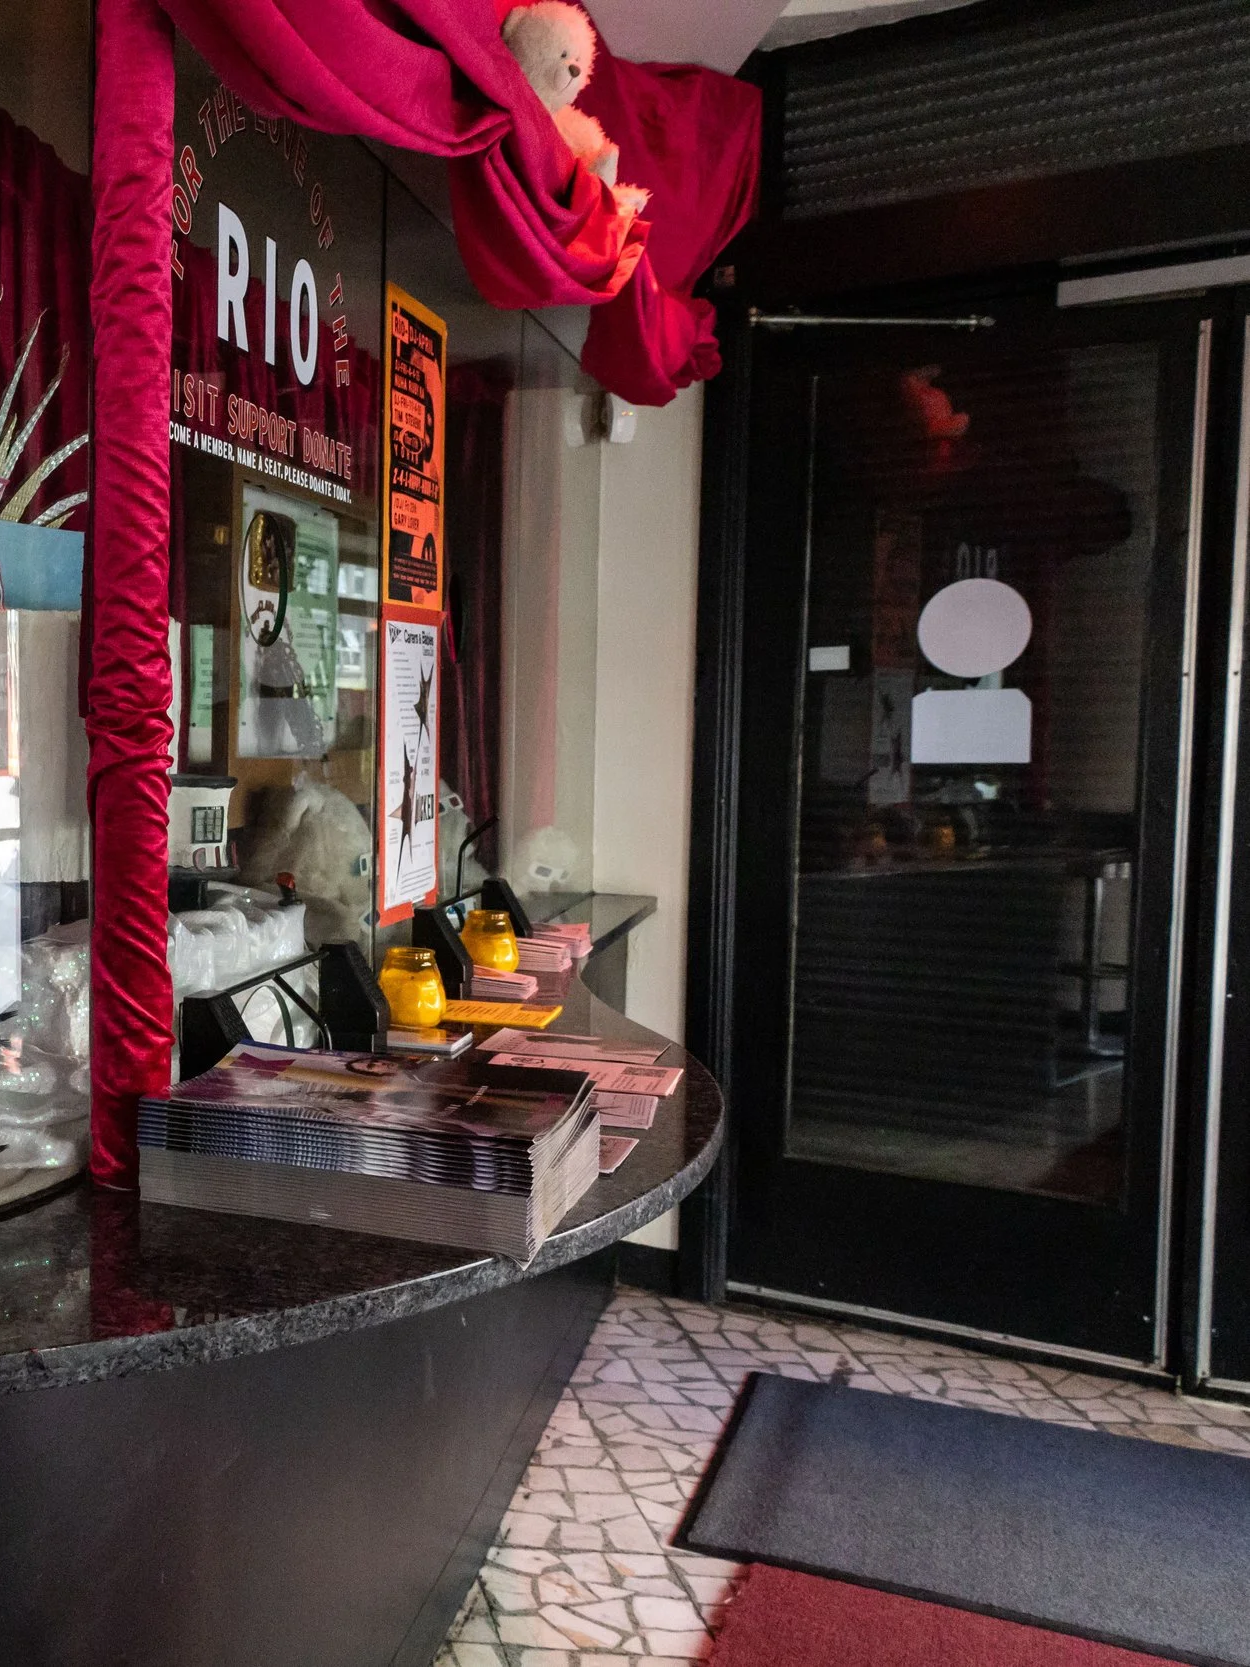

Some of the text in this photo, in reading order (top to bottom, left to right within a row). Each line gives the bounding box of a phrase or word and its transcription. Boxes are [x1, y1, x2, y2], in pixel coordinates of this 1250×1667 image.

[217, 201, 318, 386] RIO
[310, 182, 334, 249] OF
[329, 272, 350, 388] THE
[174, 368, 218, 427] ISIT
[227, 393, 297, 458] SUPPORT
[303, 427, 352, 480] DONATE
[193, 430, 199, 449] A
[200, 433, 235, 462] MEMBER.
[237, 446, 257, 470] NAME
[258, 455, 263, 472] A
[264, 457, 283, 479] SEAT.
[284, 465, 308, 488] PLEASE
[309, 475, 331, 497] DONATE
[333, 482, 352, 504] TODAY.
